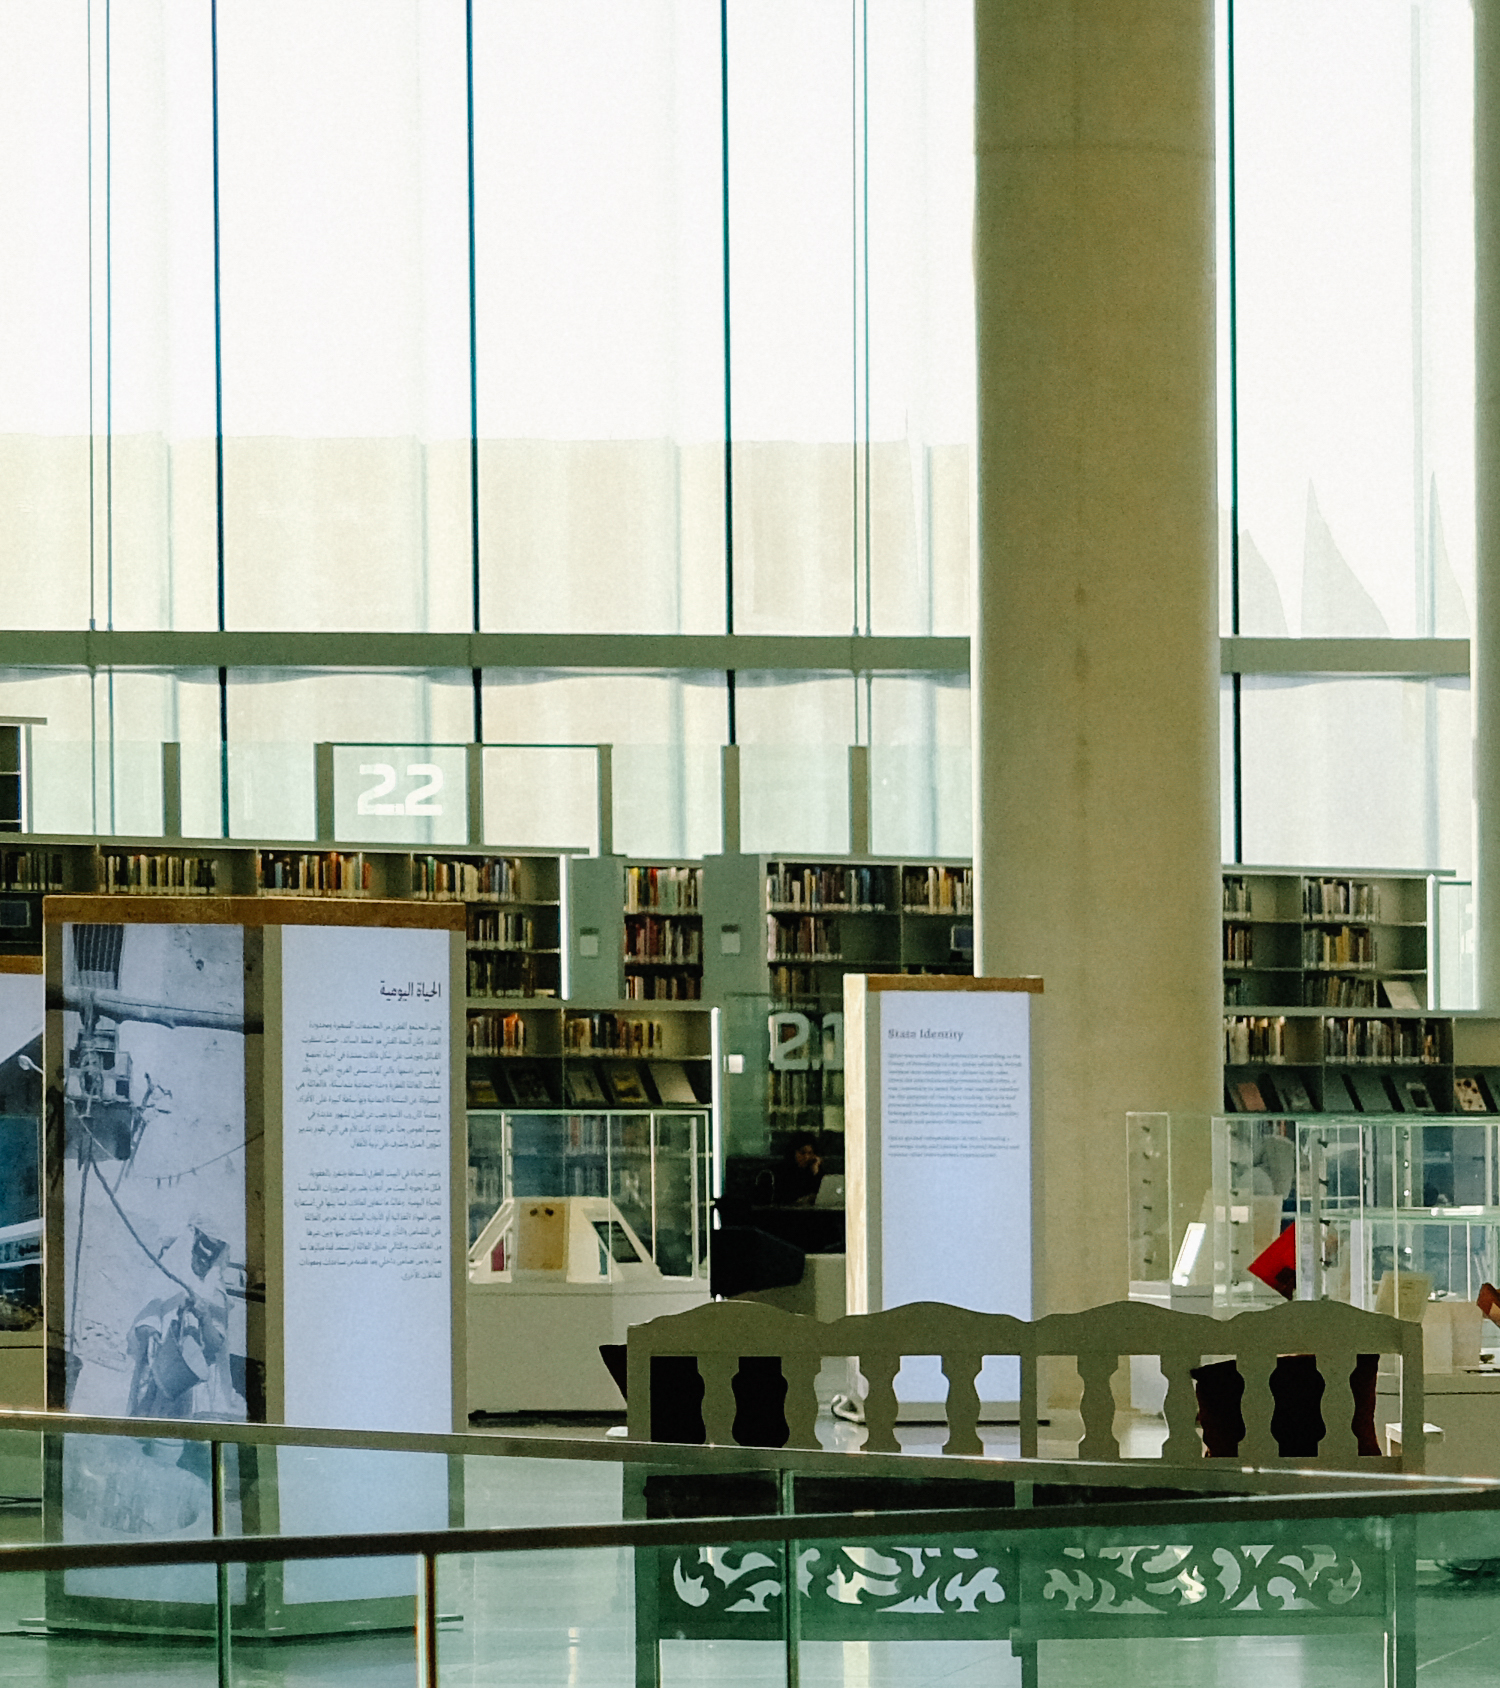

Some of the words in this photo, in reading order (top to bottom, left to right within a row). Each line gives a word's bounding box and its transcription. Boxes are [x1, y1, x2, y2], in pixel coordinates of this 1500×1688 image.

[357, 763, 443, 816] 2.2
[379, 981, 414, 1002] اليومية
[416, 981, 441, 1002] الحياة
[888, 1028, 917, 1039] State
[919, 1028, 964, 1042] Identity
